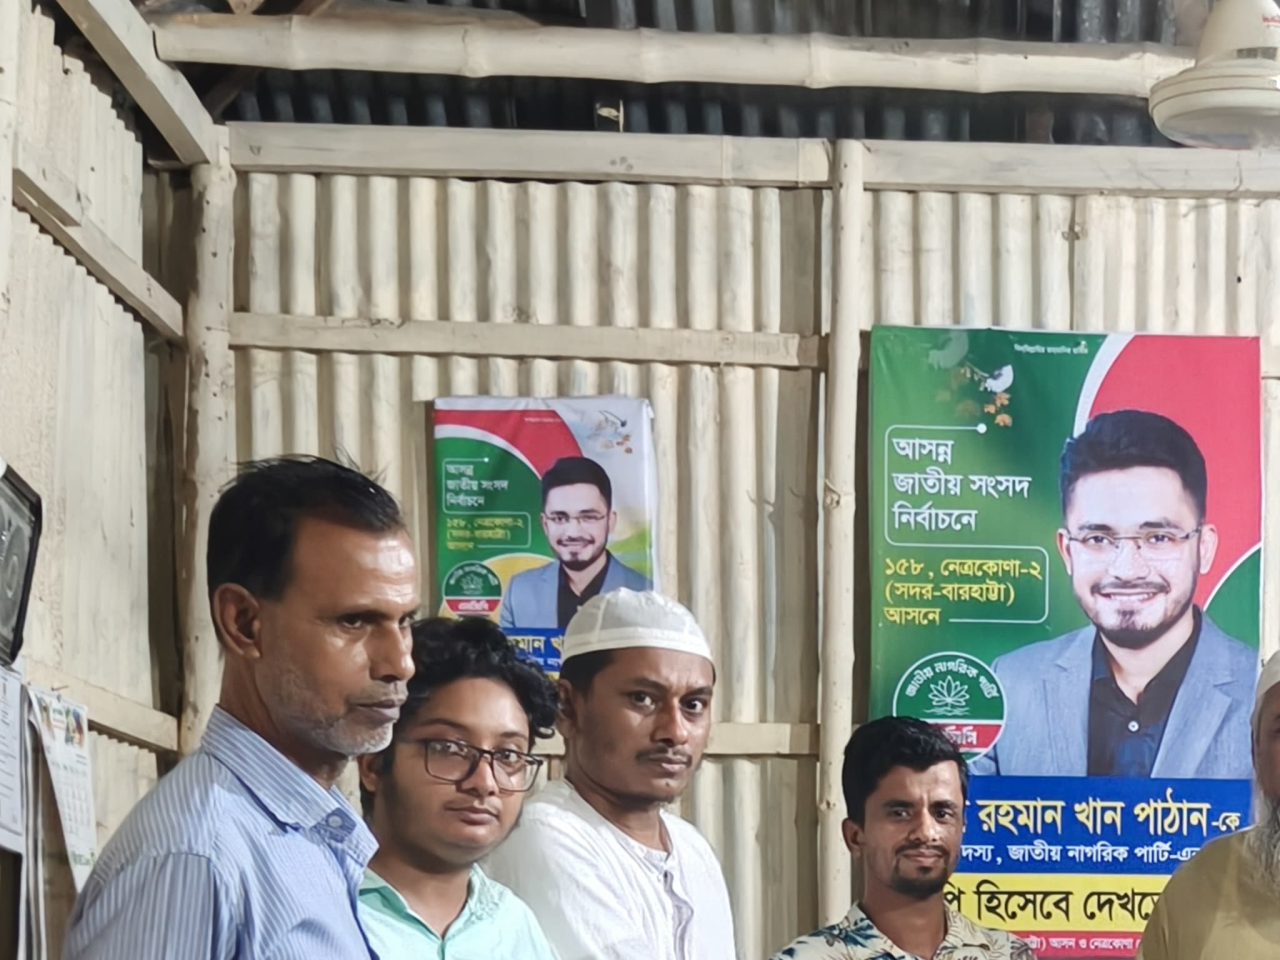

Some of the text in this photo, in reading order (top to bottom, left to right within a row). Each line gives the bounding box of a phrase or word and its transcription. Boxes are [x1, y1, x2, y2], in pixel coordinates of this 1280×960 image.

[892, 438, 954, 464] আসন্ন
[891, 466, 1032, 499] জাতীয় সংসদ
[891, 501, 978, 531] নির্বাচনে
[883, 607, 941, 626] আসনে
[976, 798, 1066, 835] রহমান
[1074, 798, 1125, 836] খান
[1007, 839, 1061, 863] জাতীয়
[1067, 840, 1128, 863] নাগরিক
[973, 880, 1074, 923] হিসেবে
